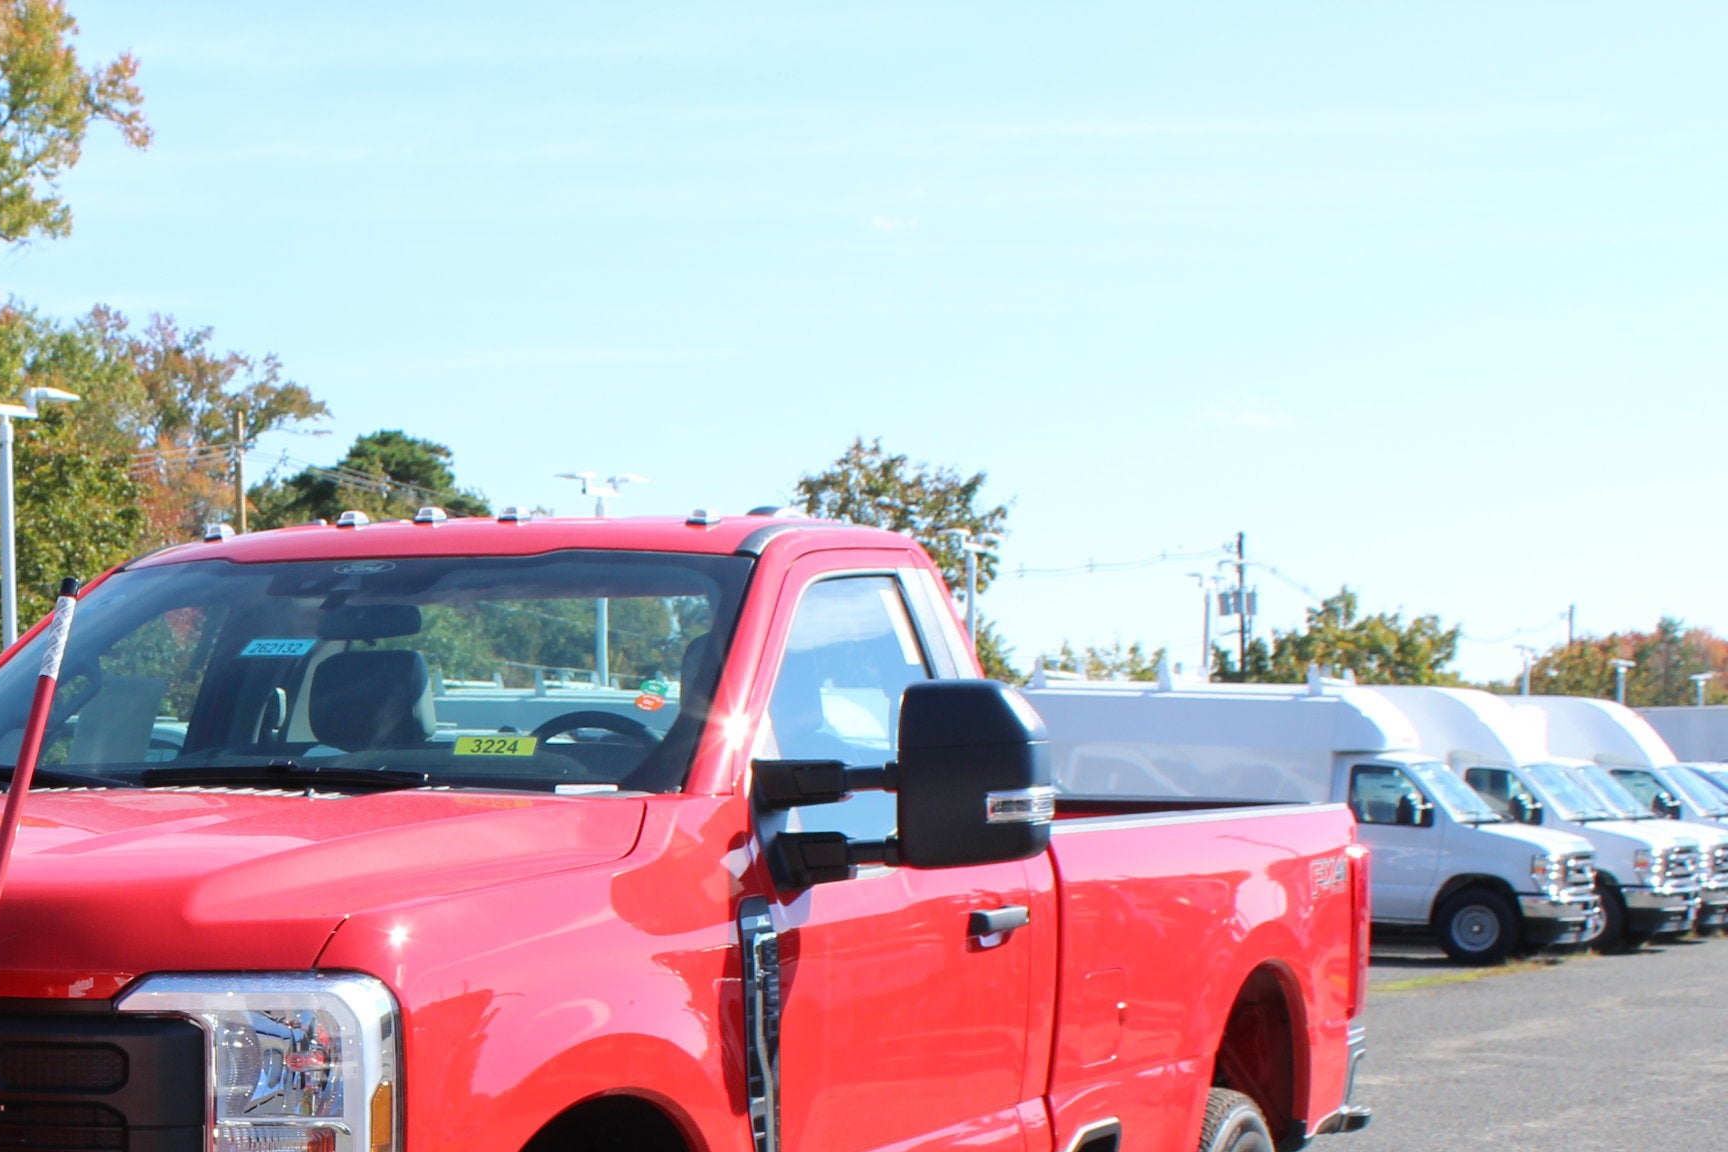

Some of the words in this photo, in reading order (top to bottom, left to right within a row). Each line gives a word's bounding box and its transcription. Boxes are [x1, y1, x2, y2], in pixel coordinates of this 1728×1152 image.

[249, 642, 304, 654] 262132
[470, 739, 518, 754] 3224
[757, 914, 771, 926] XL
